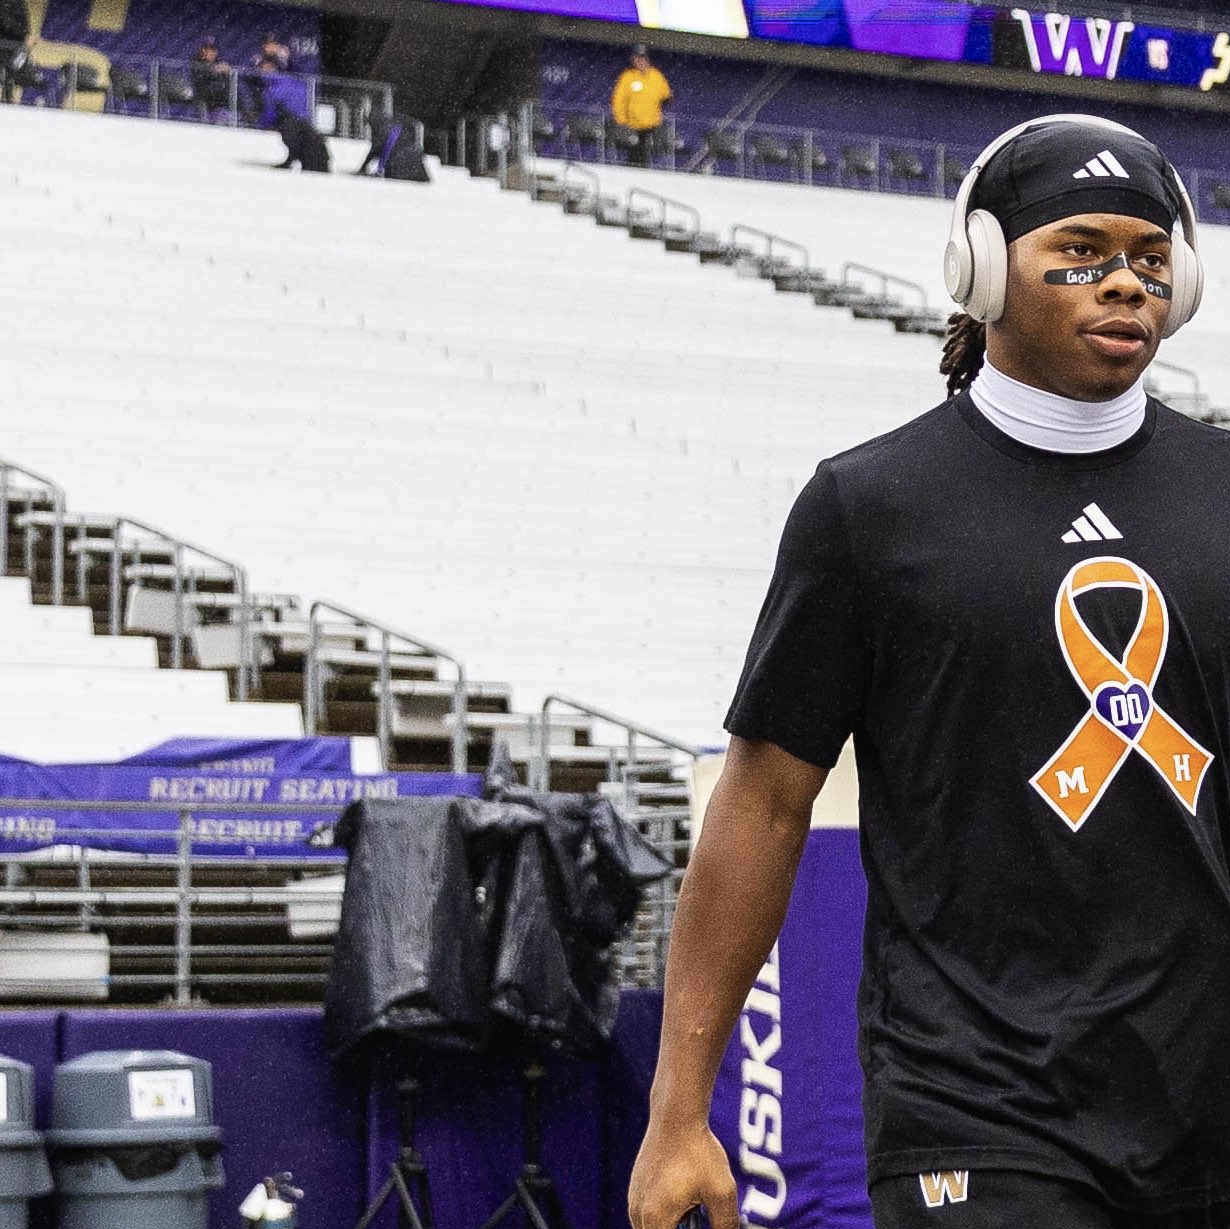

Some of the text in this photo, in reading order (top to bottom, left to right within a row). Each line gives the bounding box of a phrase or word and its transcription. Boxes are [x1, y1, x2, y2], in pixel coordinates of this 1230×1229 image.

[1066, 269, 1104, 285] God's
[1054, 765, 1089, 798] M
[1172, 754, 1192, 782] H
[150, 777, 398, 801] RECRUIT SEATING
[919, 1170, 969, 1208] W
